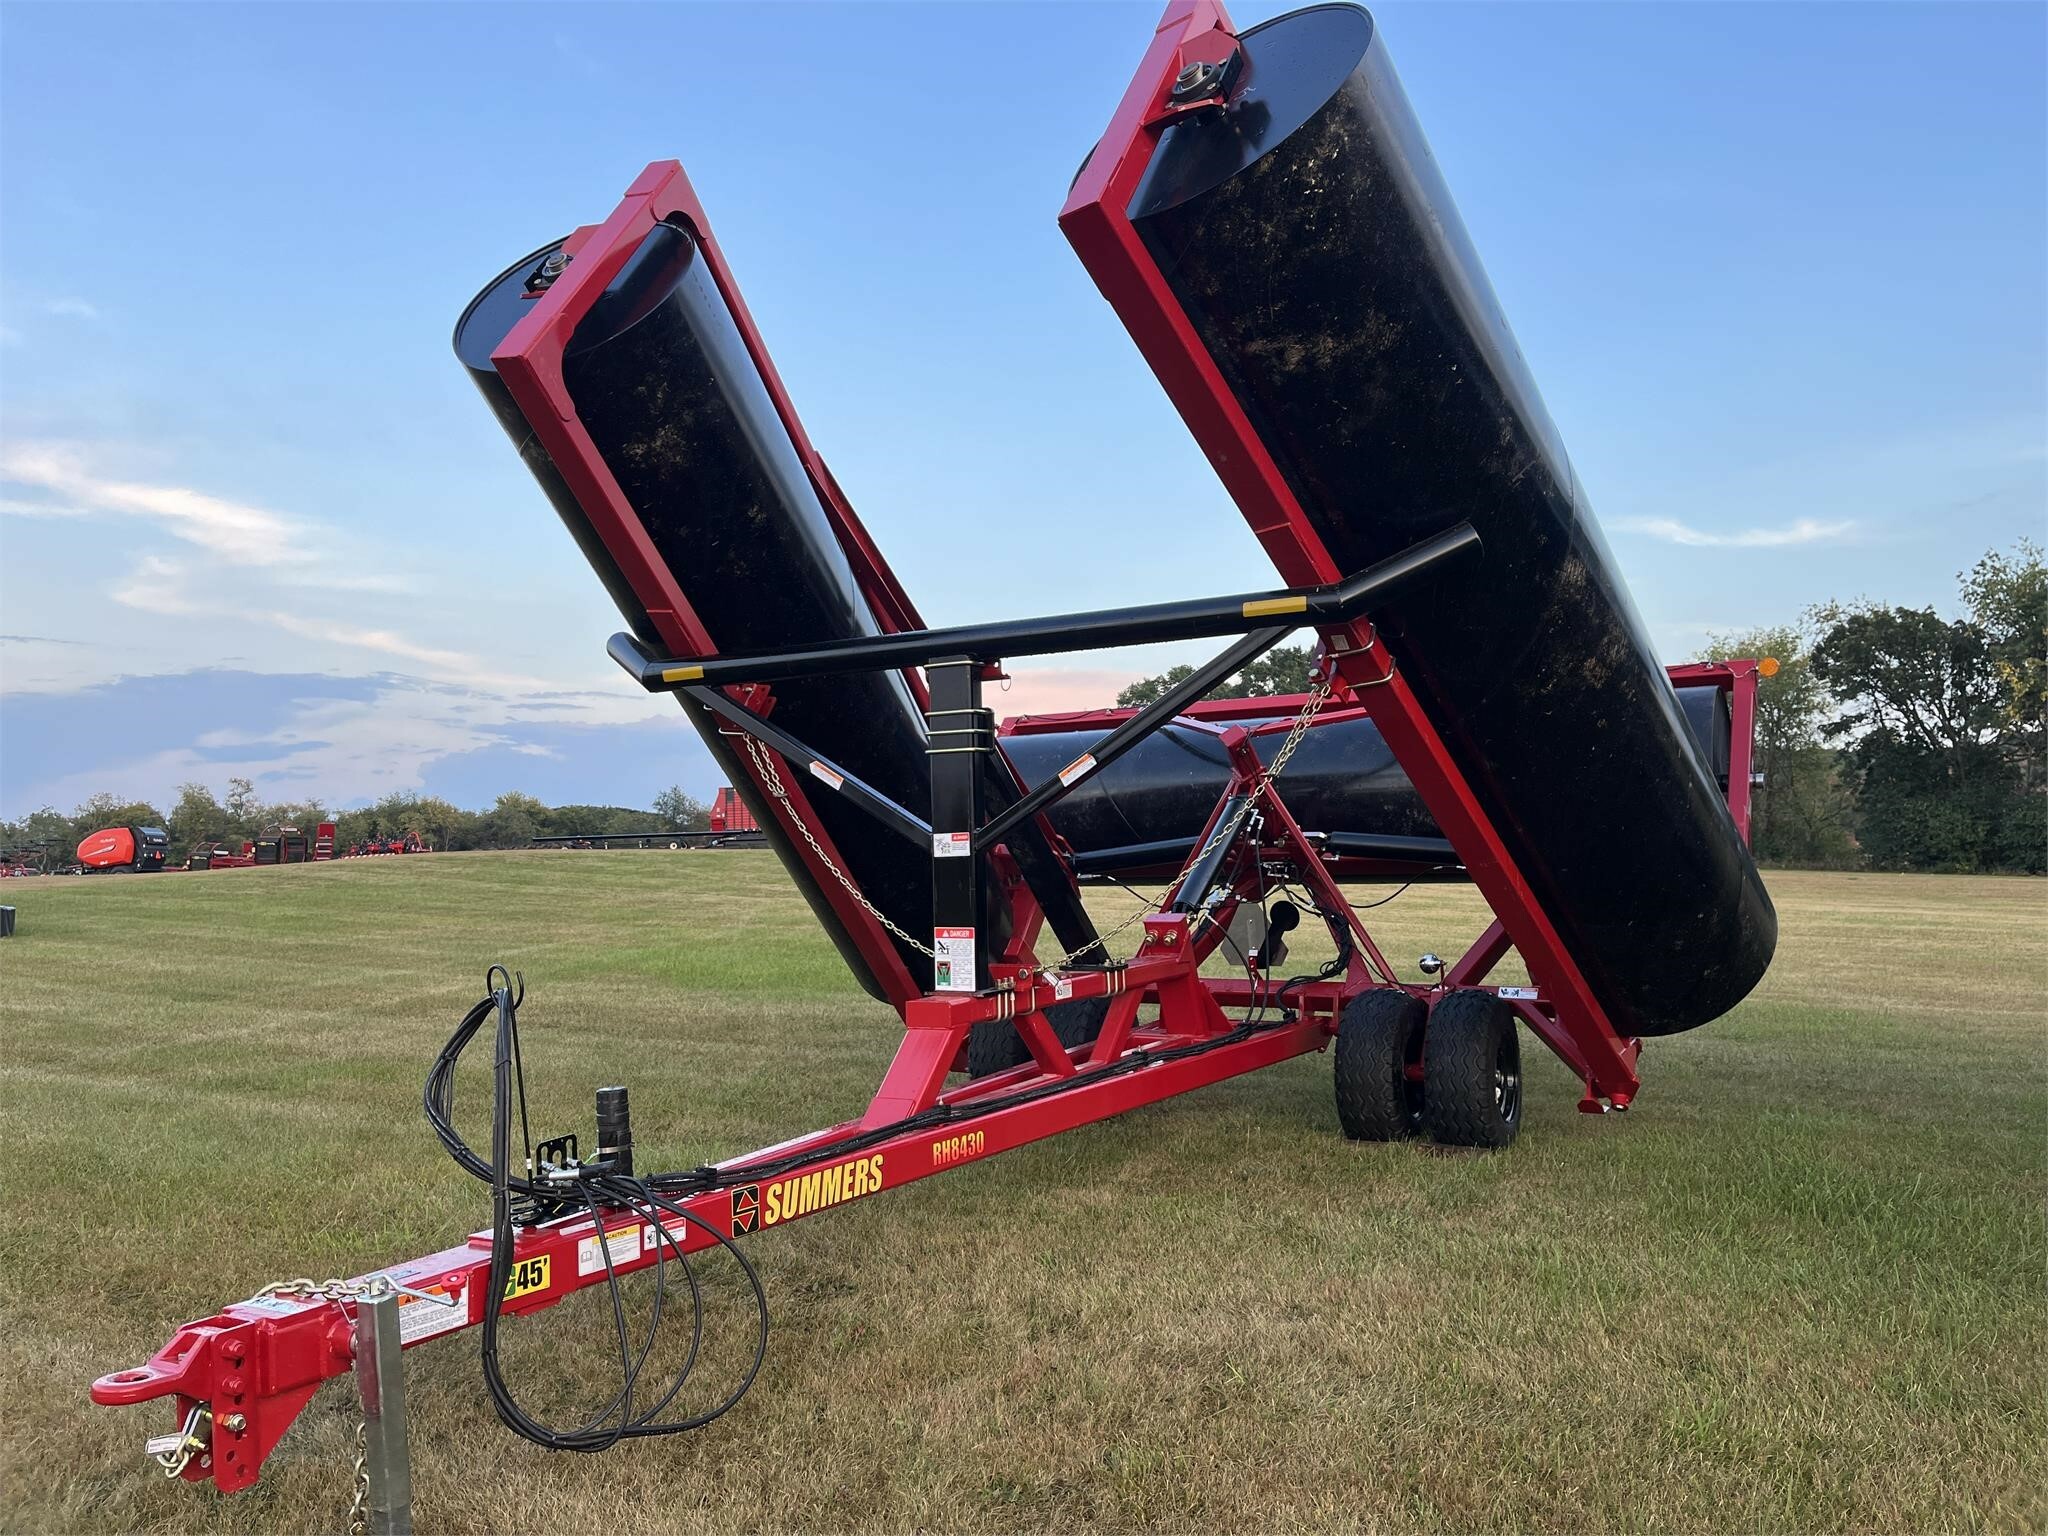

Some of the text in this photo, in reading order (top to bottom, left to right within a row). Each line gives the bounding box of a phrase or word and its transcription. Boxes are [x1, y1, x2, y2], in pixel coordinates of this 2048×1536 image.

[949, 929, 970, 938] DANGER
[932, 1130, 985, 1166] RH8430
[764, 1154, 884, 1226] SUMMERS
[608, 1230, 628, 1238] CAUTION
